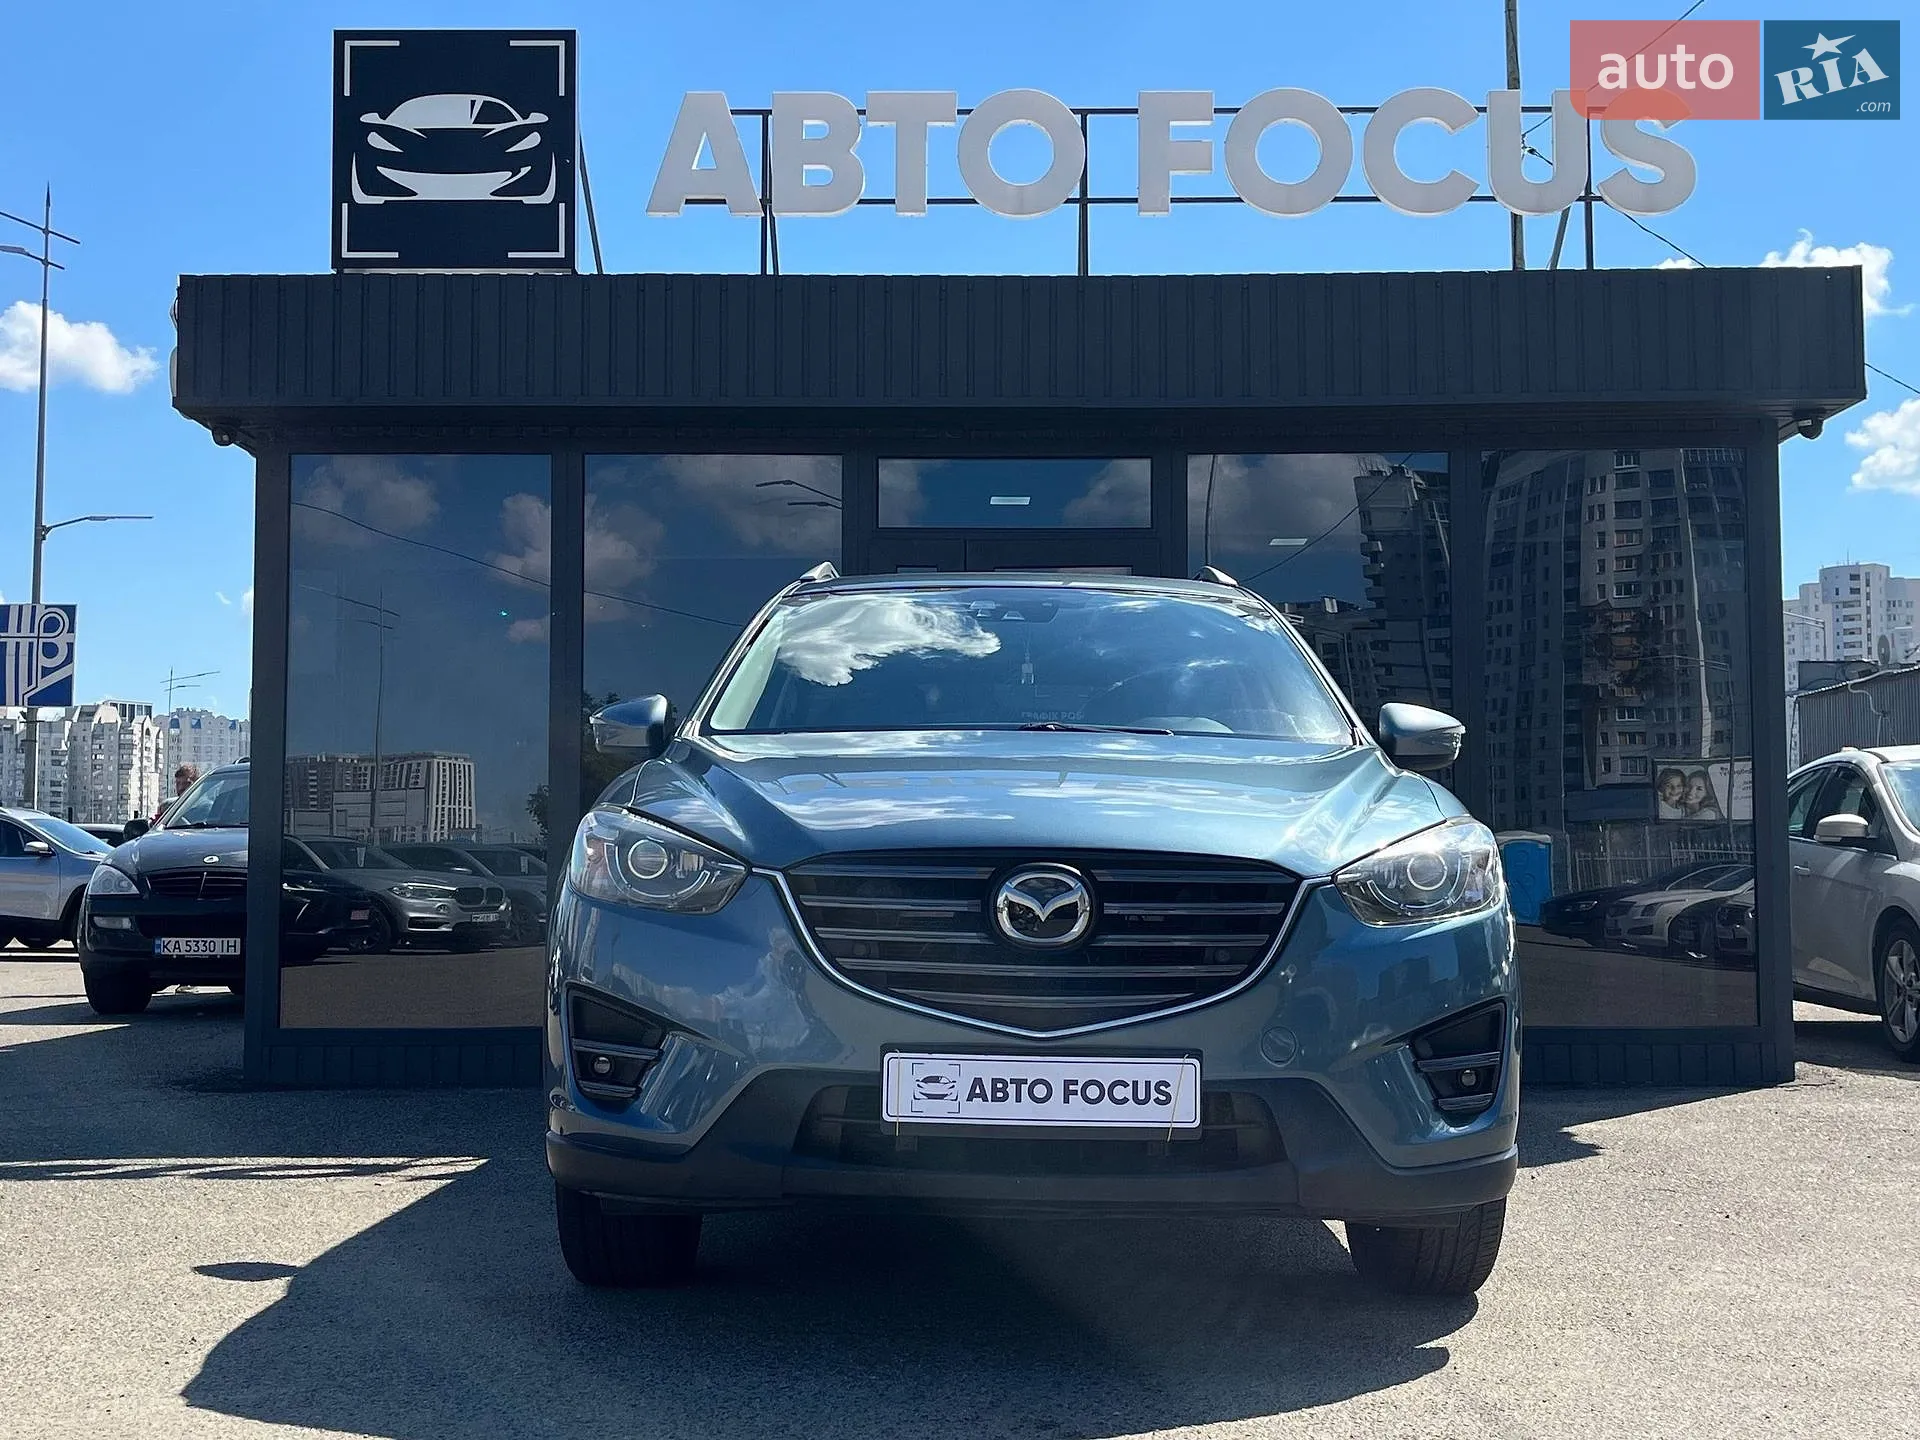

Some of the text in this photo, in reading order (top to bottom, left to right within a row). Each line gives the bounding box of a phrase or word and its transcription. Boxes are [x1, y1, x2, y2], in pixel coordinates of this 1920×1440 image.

[646, 87, 1698, 219] АВТО FOCUS
[162, 940, 237, 953] KA 5330 IH
[966, 1077, 1172, 1106] АВТО FOCUS
